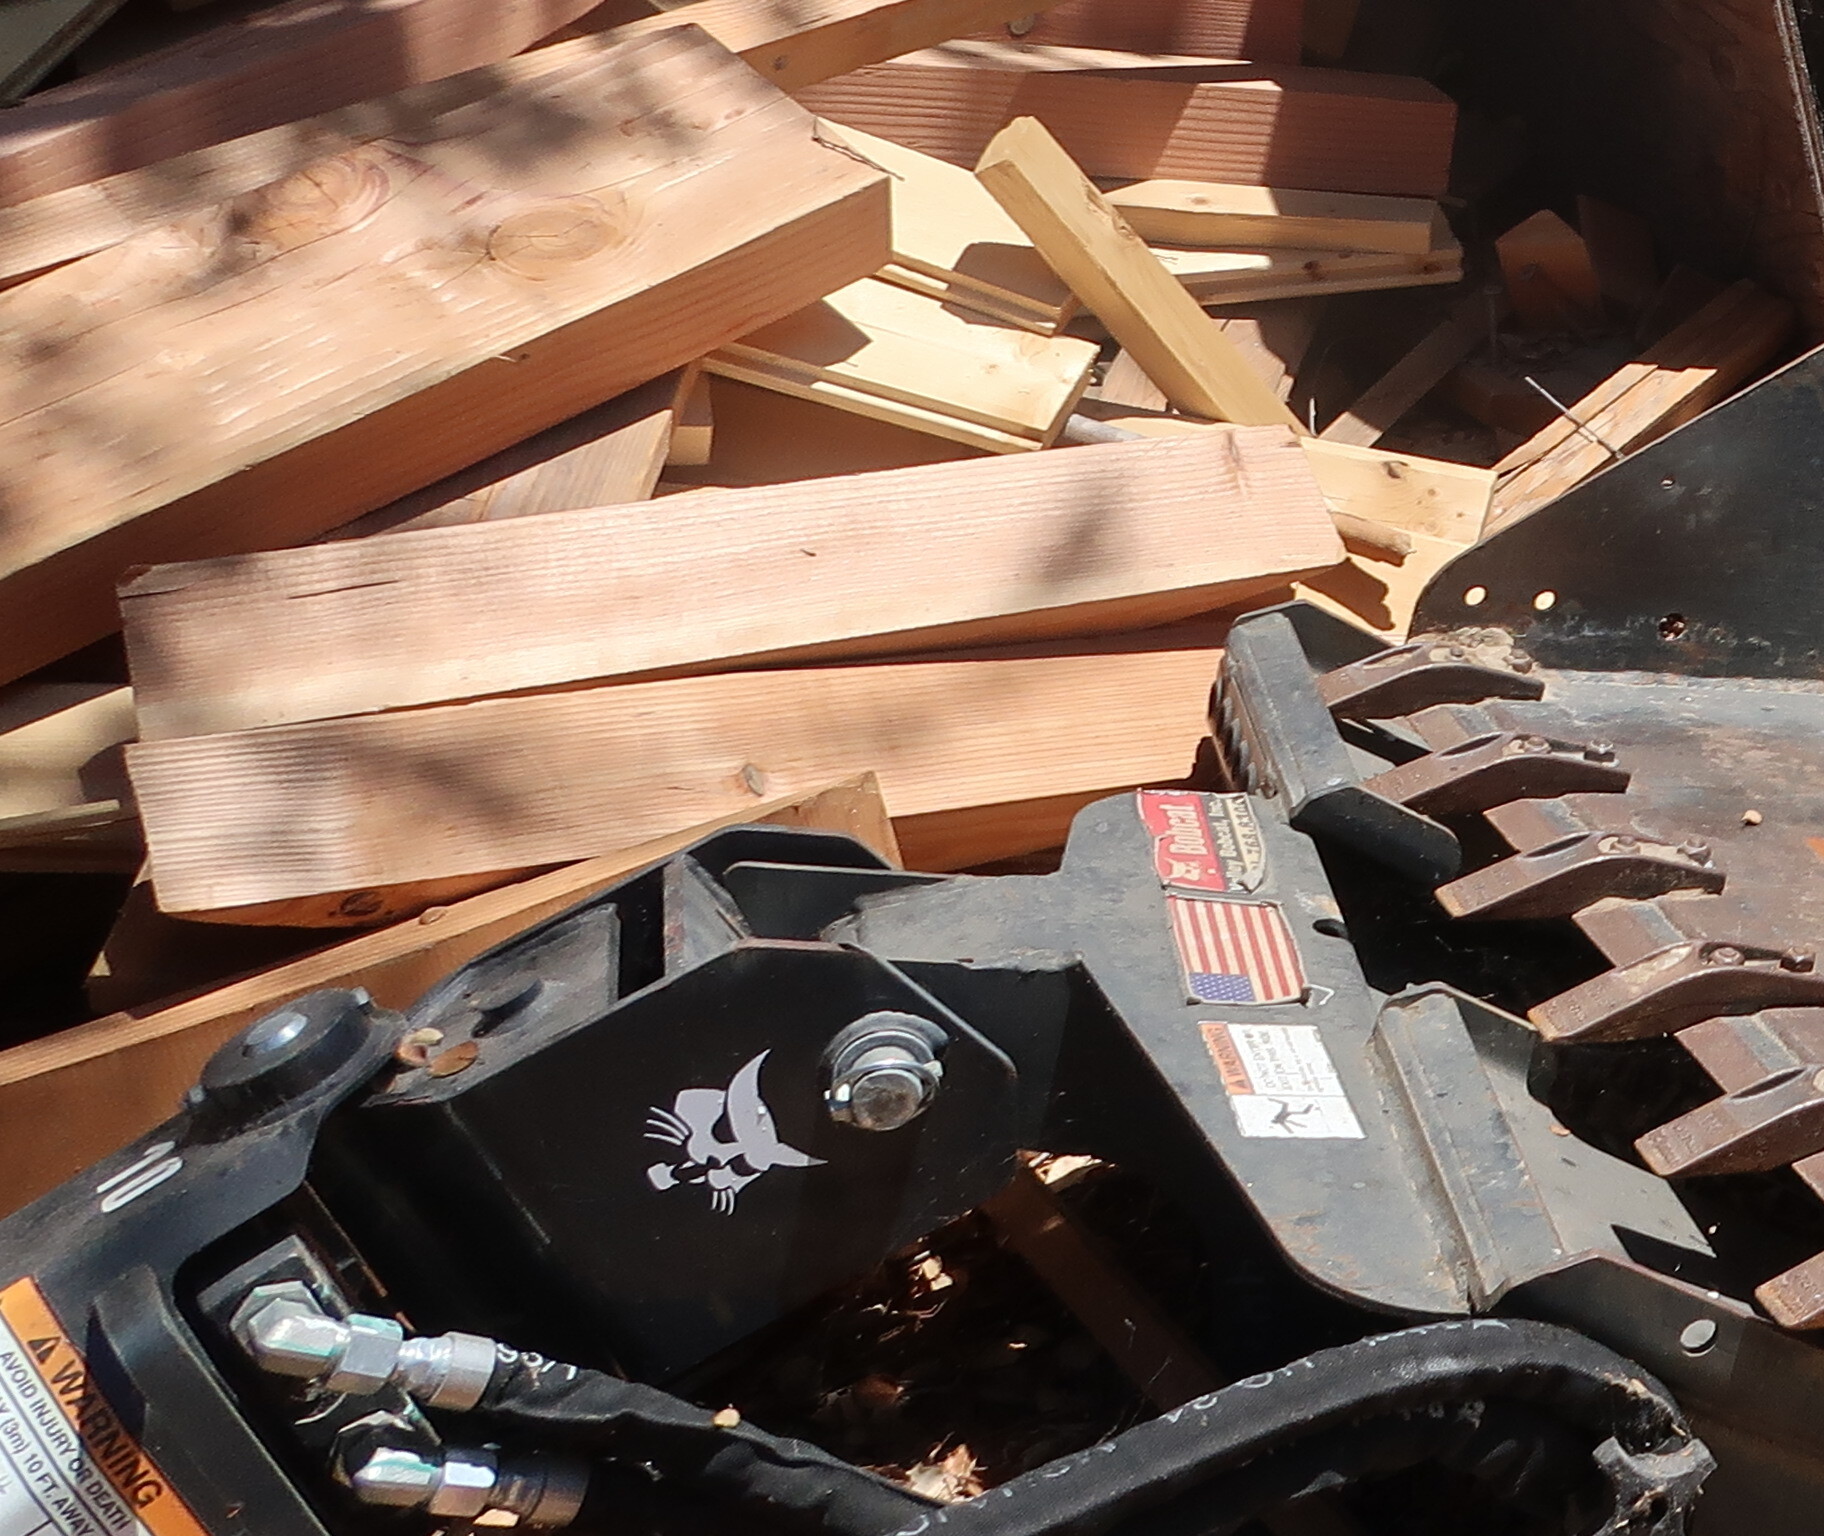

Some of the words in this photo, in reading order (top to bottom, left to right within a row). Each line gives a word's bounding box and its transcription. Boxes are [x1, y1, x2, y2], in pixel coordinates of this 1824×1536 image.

[1158, 803, 1209, 856] Bobcat
[1206, 1026, 1243, 1077] WARNING
[30, 1397, 77, 1457] INJURY
[68, 1456, 94, 1485] OR
[86, 1482, 132, 1532] DEATH
[51, 1359, 163, 1510] WARNING
[23, 1452, 44, 1475] 10
[51, 1496, 95, 1536] AWAY
